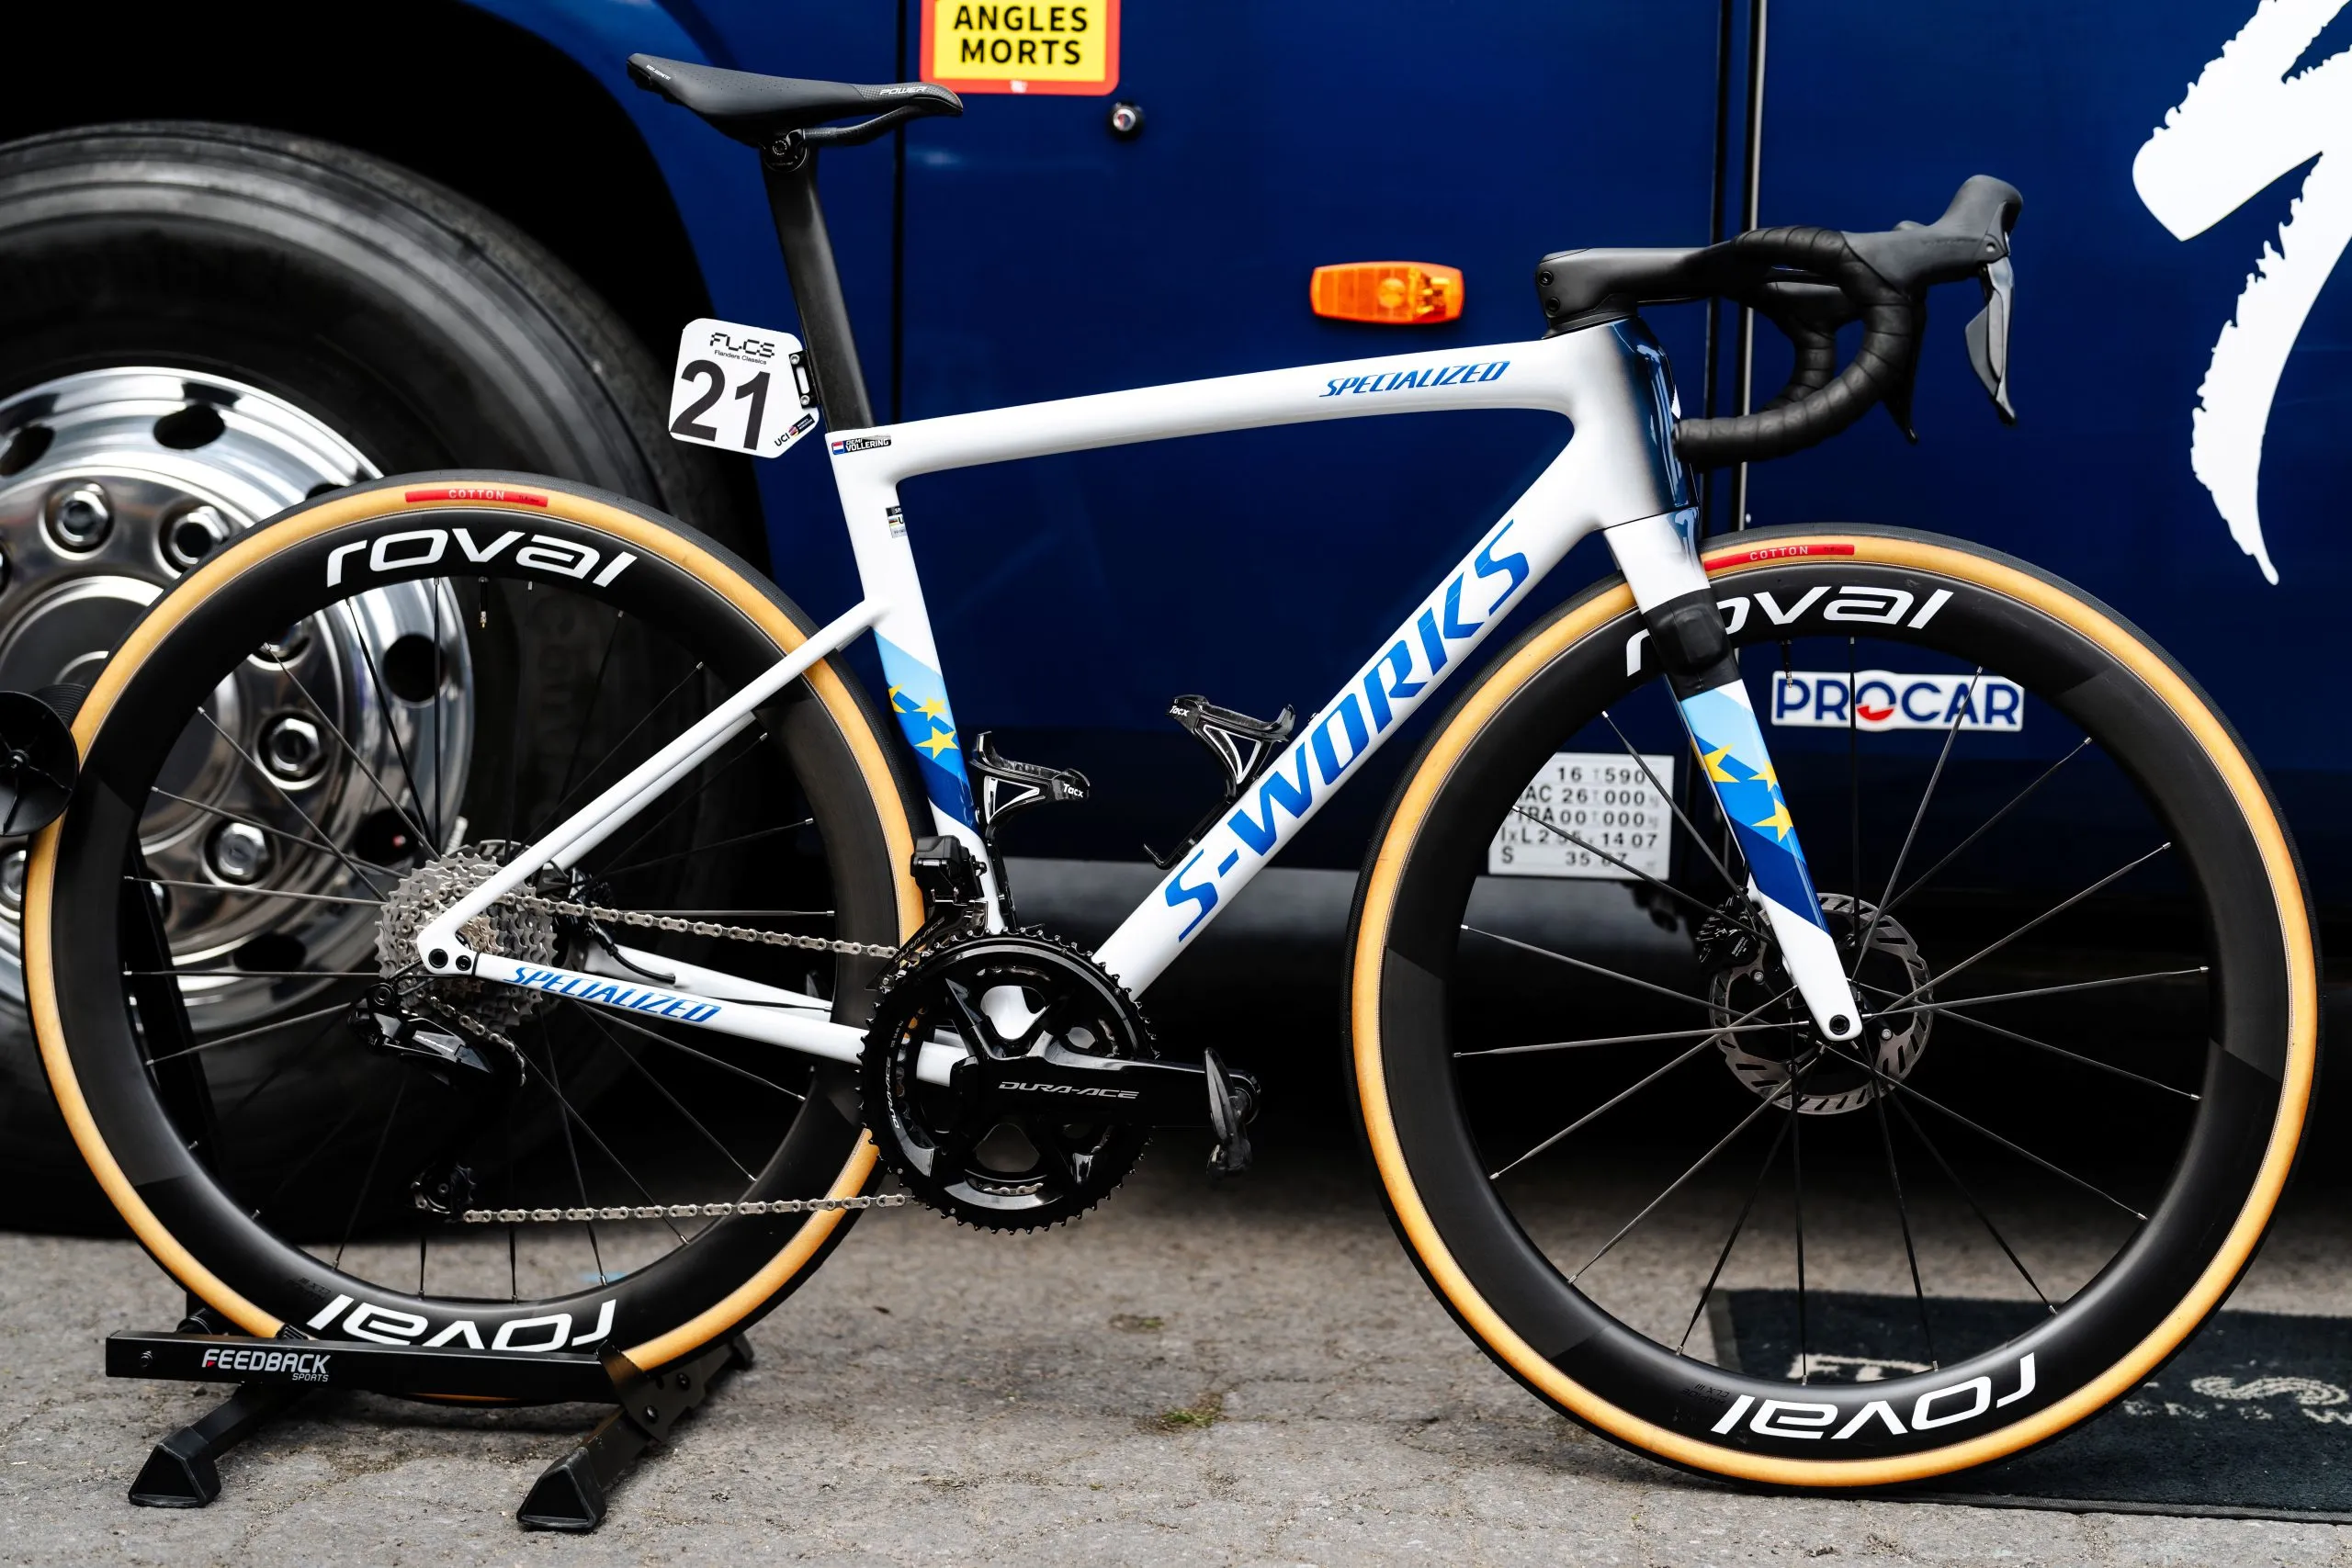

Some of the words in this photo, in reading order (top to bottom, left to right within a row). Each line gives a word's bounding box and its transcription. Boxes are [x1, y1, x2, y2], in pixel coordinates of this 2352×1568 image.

[954, 6, 1088, 32] ANGLES
[961, 39, 1080, 65] MORTS
[879, 86, 928, 96] POWER
[709, 332, 775, 358] FLCS
[714, 349, 741, 360] Flanders
[741, 355, 767, 366] Classics
[1318, 360, 1511, 398] SPECIALIZED
[670, 359, 771, 451] 21
[775, 432, 791, 447] UCI
[845, 438, 889, 452] VOLLERING
[448, 489, 505, 501] COTTON
[326, 527, 639, 588] roval
[1749, 546, 1809, 561] COTTON
[1169, 705, 1191, 717] Tacx
[1775, 678, 2021, 726] PROCAR
[1164, 517, 1532, 944] S-WORKS
[1558, 766, 1582, 783] 16
[1604, 766, 1646, 784] 590
[1063, 783, 1084, 798] Tacx
[1562, 787, 1589, 805] 26
[1604, 790, 1645, 806] 000
[1602, 810, 1645, 828] 000
[1501, 845, 1514, 865] S
[503, 966, 723, 1022] SPECIALIZED
[998, 1081, 1140, 1100] DURA-ACE
[306, 1293, 617, 1352] roval
[201, 1348, 332, 1374] FEEDBACK
[291, 1372, 330, 1382] SPORTS
[1710, 1351, 2036, 1440] roval
